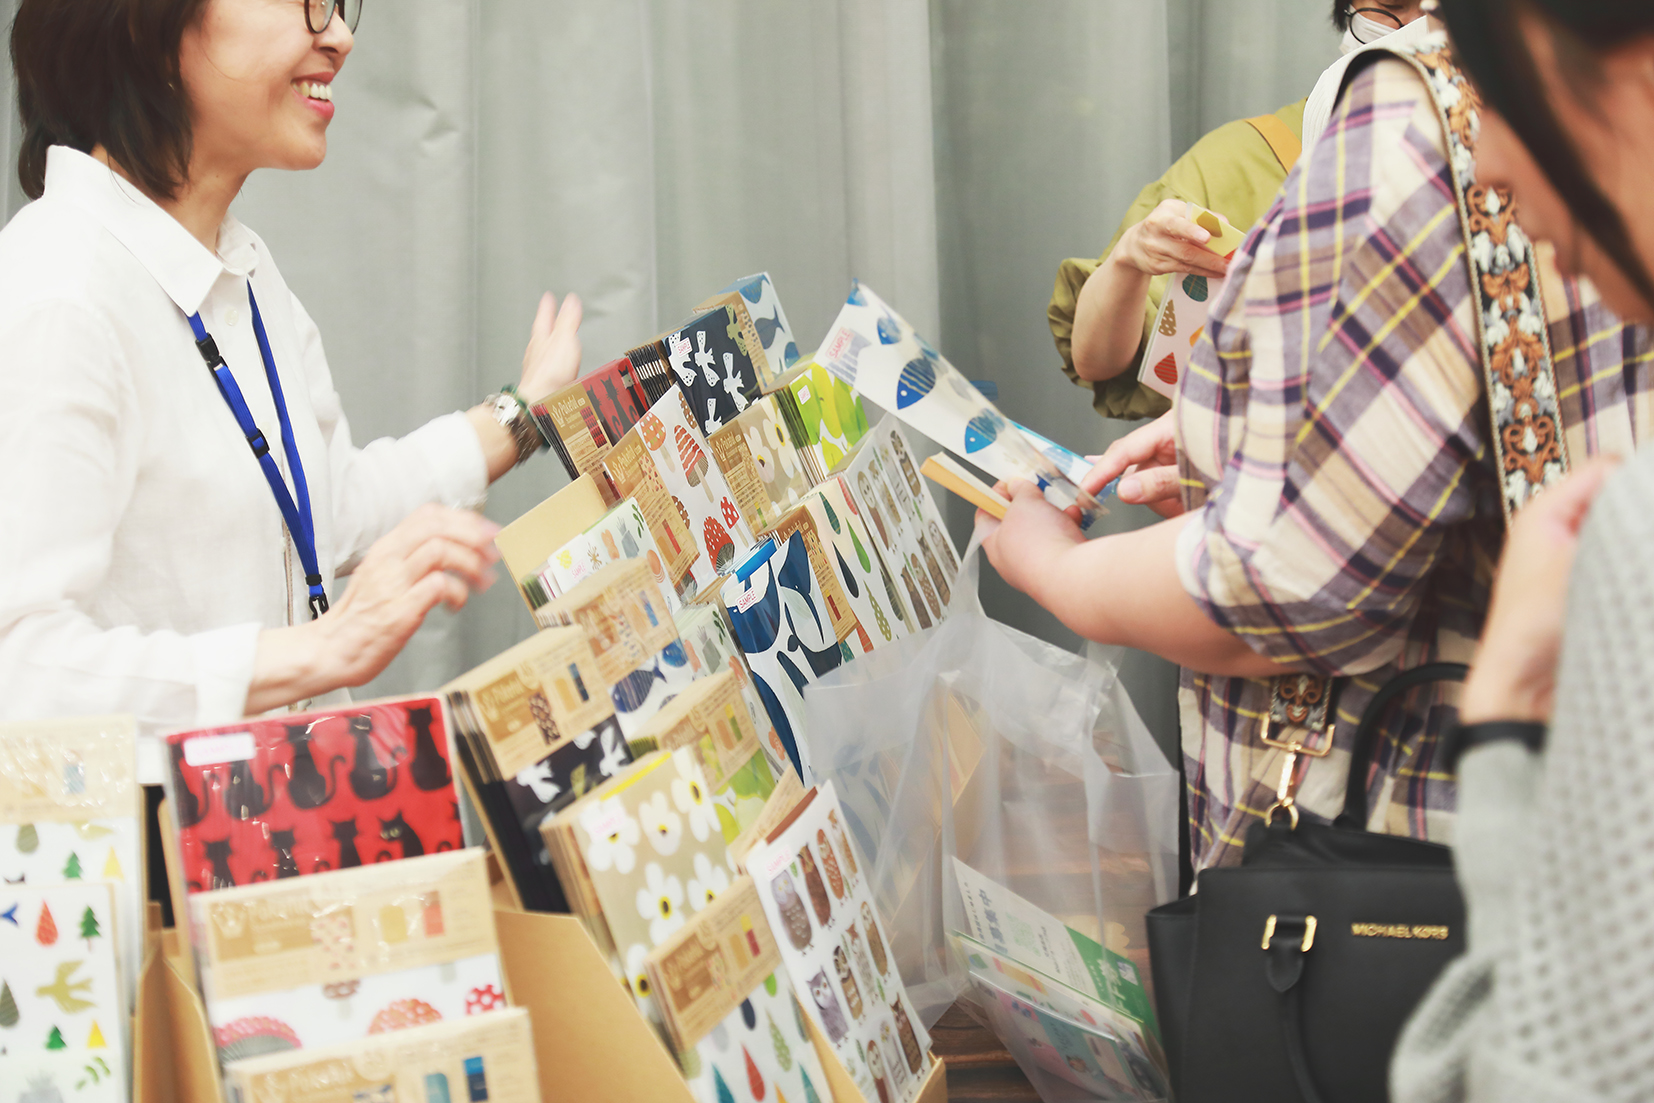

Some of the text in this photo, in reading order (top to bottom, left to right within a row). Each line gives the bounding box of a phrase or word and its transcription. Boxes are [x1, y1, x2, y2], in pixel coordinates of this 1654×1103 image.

[829, 330, 851, 359] SAMPLE
[738, 590, 757, 609] SAMPLE
[1351, 922, 1449, 940] MICHAEL KORS
